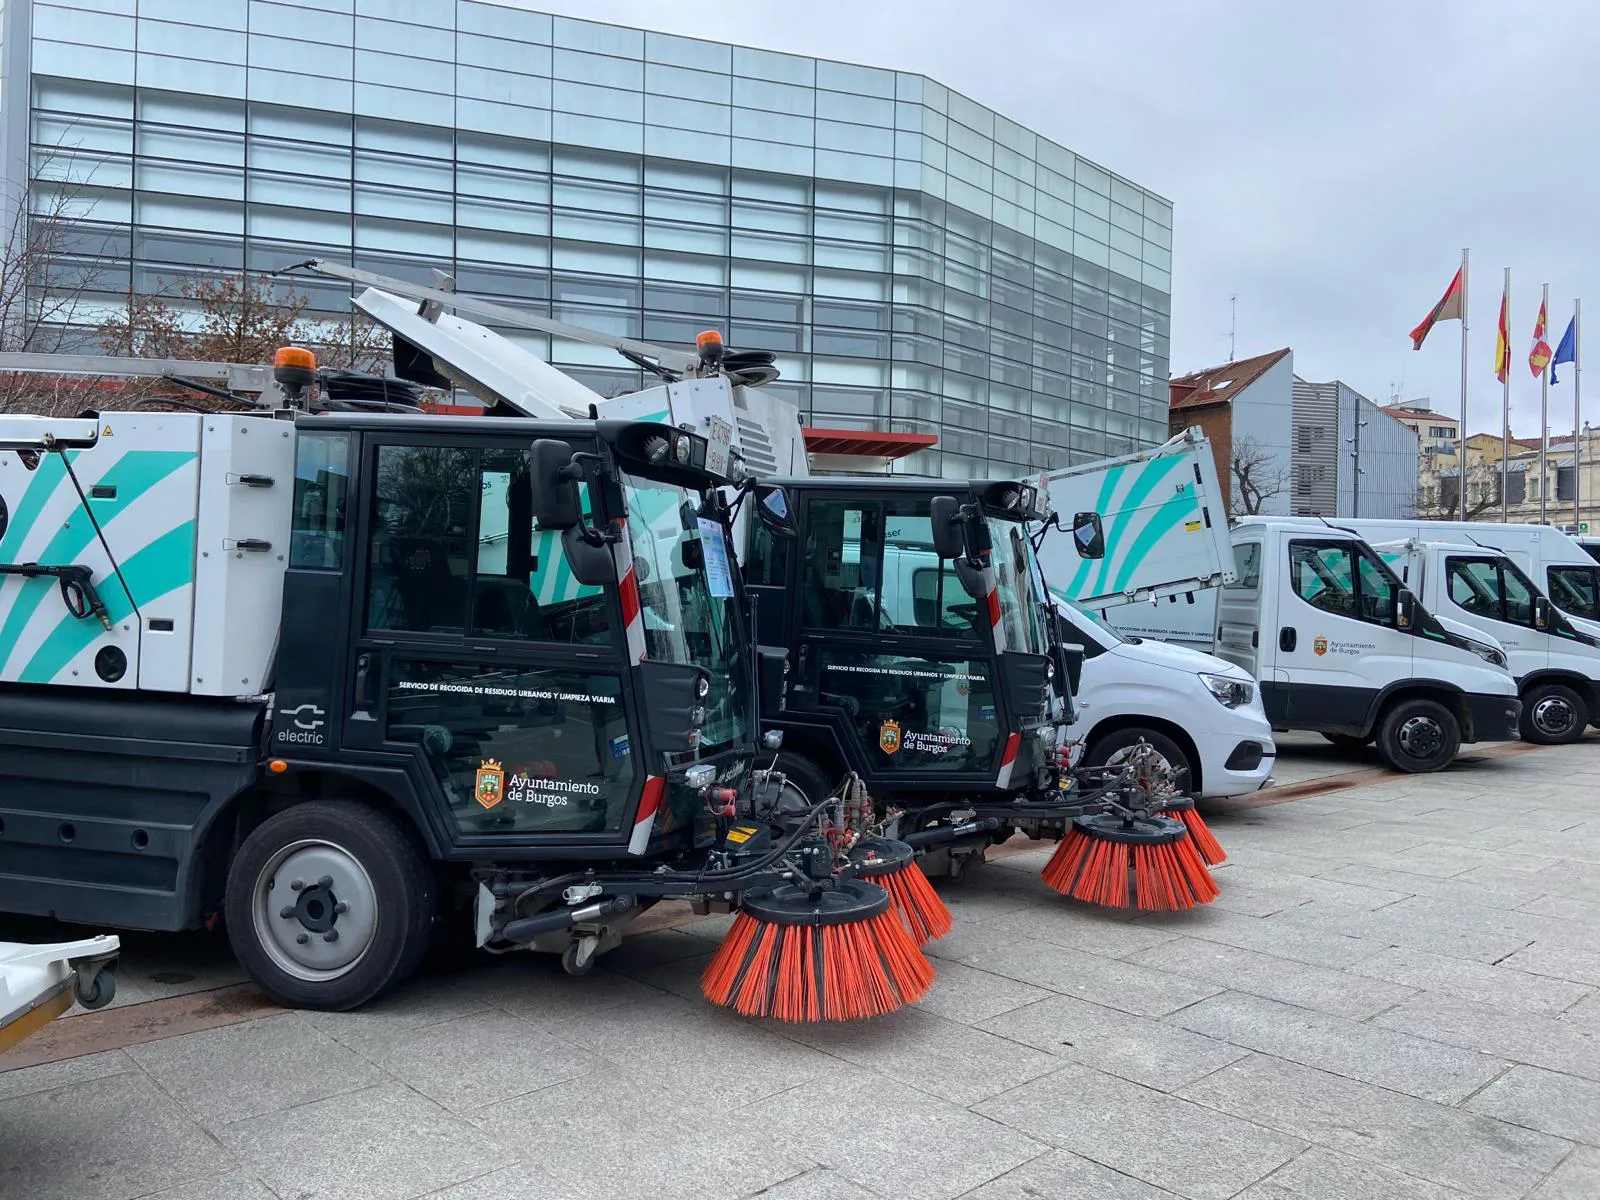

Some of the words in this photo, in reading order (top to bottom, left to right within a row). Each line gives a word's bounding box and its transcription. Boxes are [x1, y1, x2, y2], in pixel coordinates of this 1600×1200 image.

[1330, 641, 1376, 649] Ayuntamiento
[399, 681, 428, 690] SERVICIO
[440, 684, 473, 693] RECOGIDA
[484, 688, 517, 697] RESIDUOS
[518, 690, 552, 699] URBANOS
[560, 693, 590, 702] LIMPIEZA
[592, 695, 615, 704] VIARIA
[278, 729, 323, 744] electric
[904, 730, 970, 746] Ayuntamiento
[904, 740, 914, 749] de
[917, 741, 947, 754] Burgos
[510, 774, 599, 794] Ayuntamiento
[508, 790, 522, 801] de
[526, 791, 568, 808] Burgos
